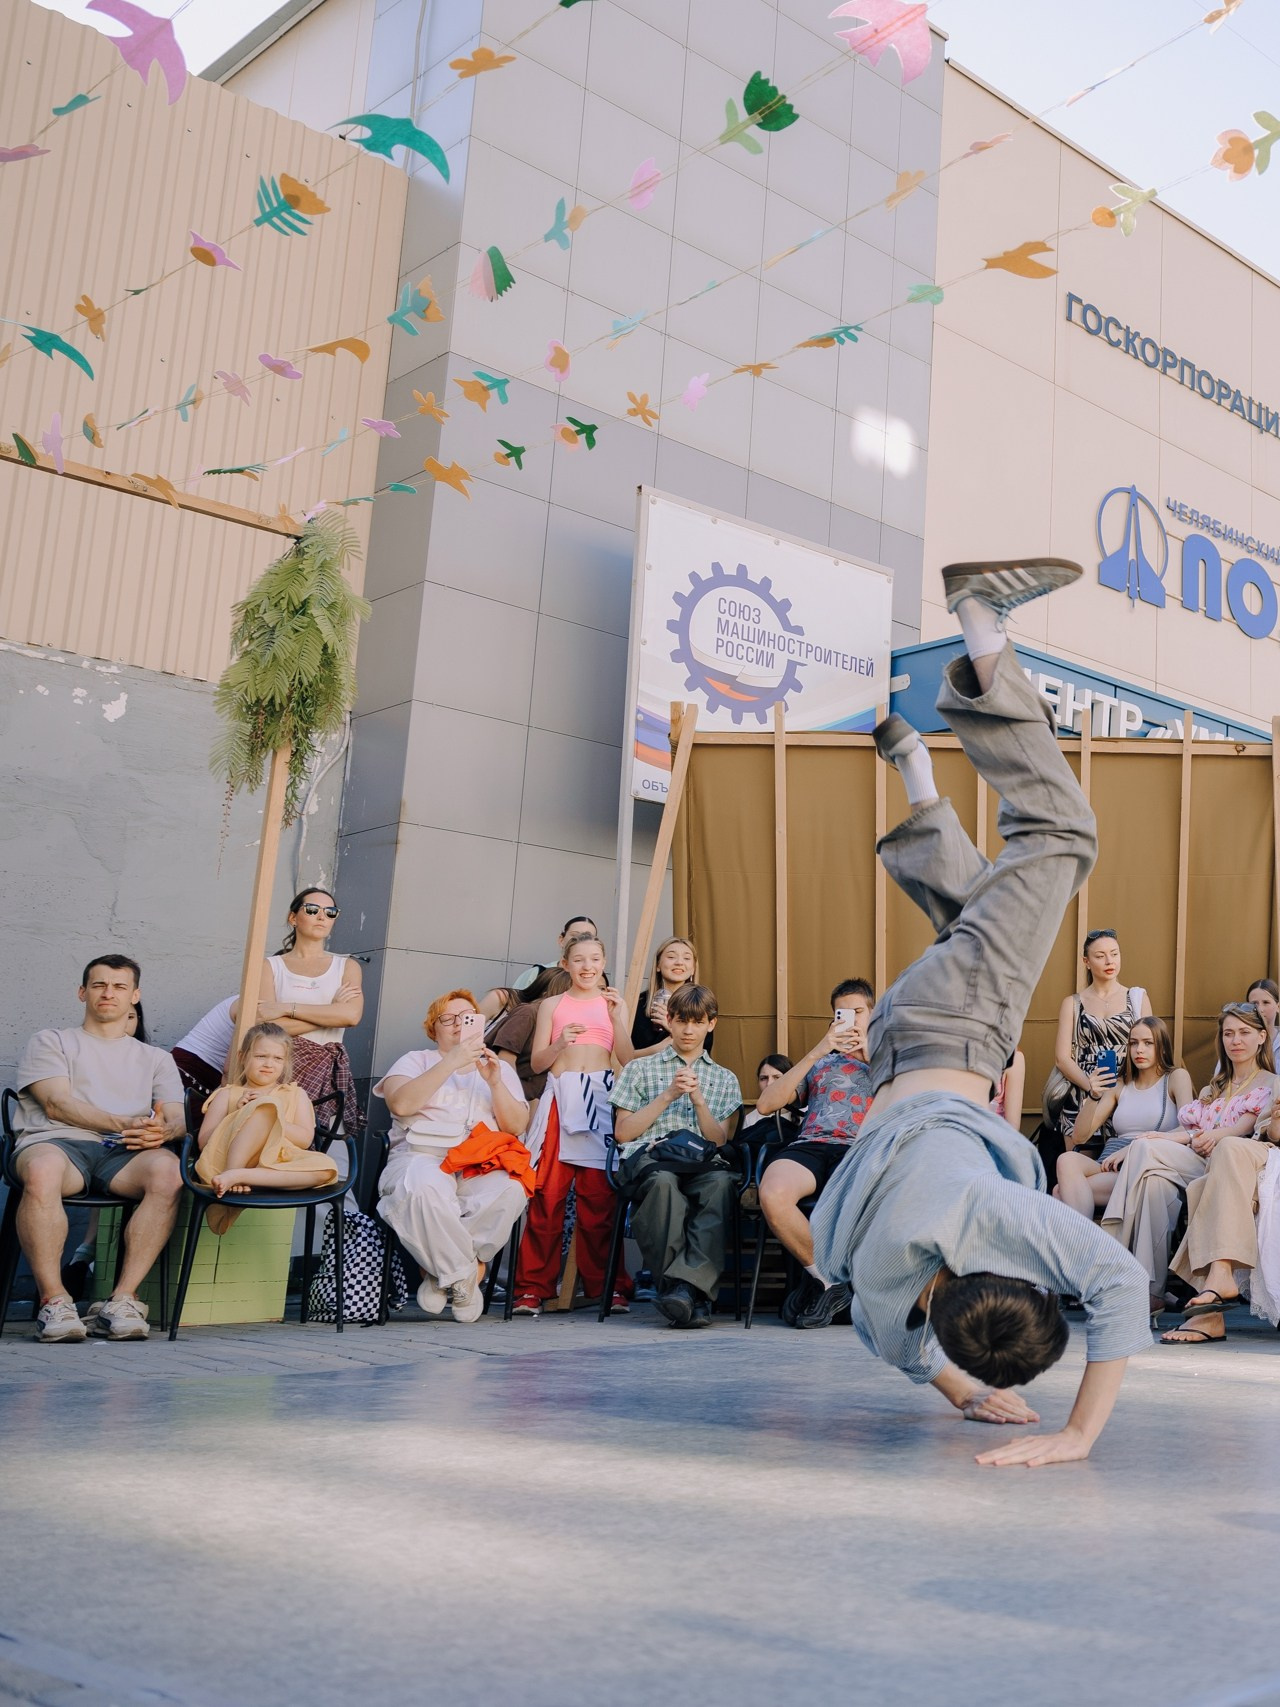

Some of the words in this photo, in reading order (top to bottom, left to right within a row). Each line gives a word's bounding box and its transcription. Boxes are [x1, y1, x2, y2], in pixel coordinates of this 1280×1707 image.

[717, 597, 762, 625] СОЮЗ
[715, 637, 775, 669] РОССИИ
[716, 617, 875, 678] МАШИНОСТРОИТЕЛЕЙ
[1024, 668, 1143, 738] ЕНТР
[642, 779, 669, 793] ОБЪ
